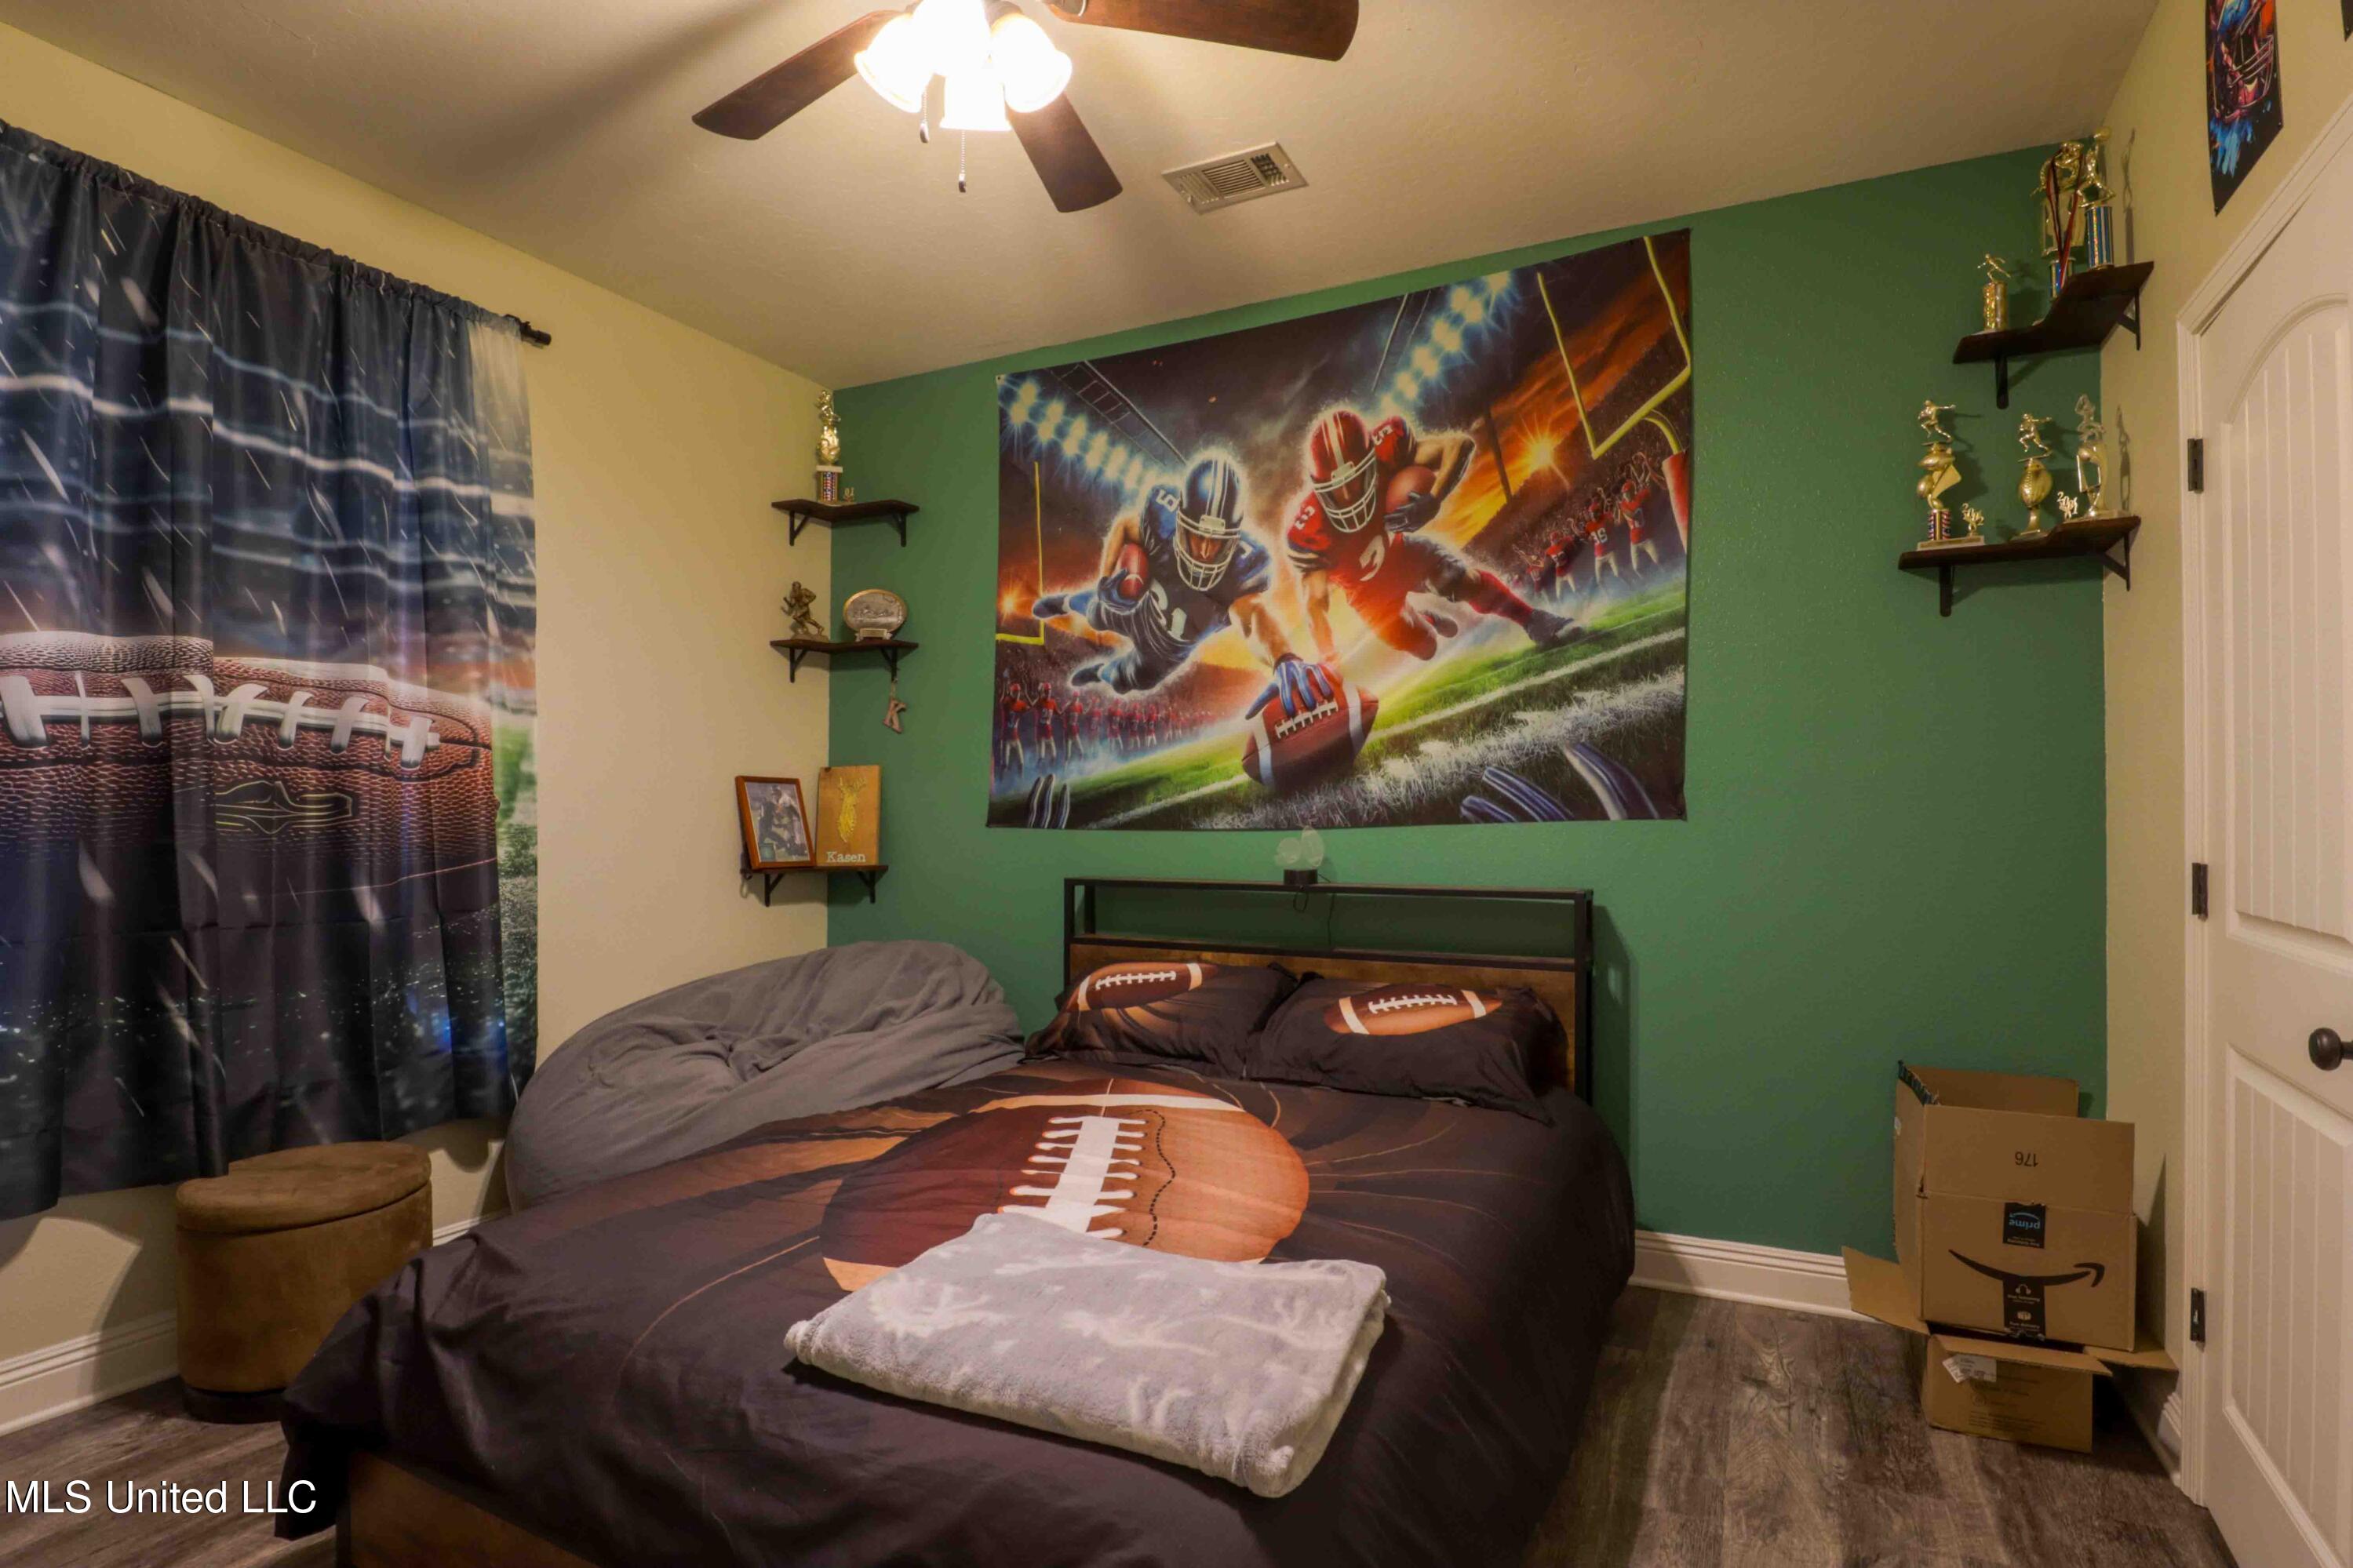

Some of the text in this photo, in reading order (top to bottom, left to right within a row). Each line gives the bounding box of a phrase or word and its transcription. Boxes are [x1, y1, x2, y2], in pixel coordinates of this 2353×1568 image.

[826, 851, 865, 863] Kasen
[2015, 1151, 2038, 1167] 176
[2009, 1219, 2041, 1230] prime
